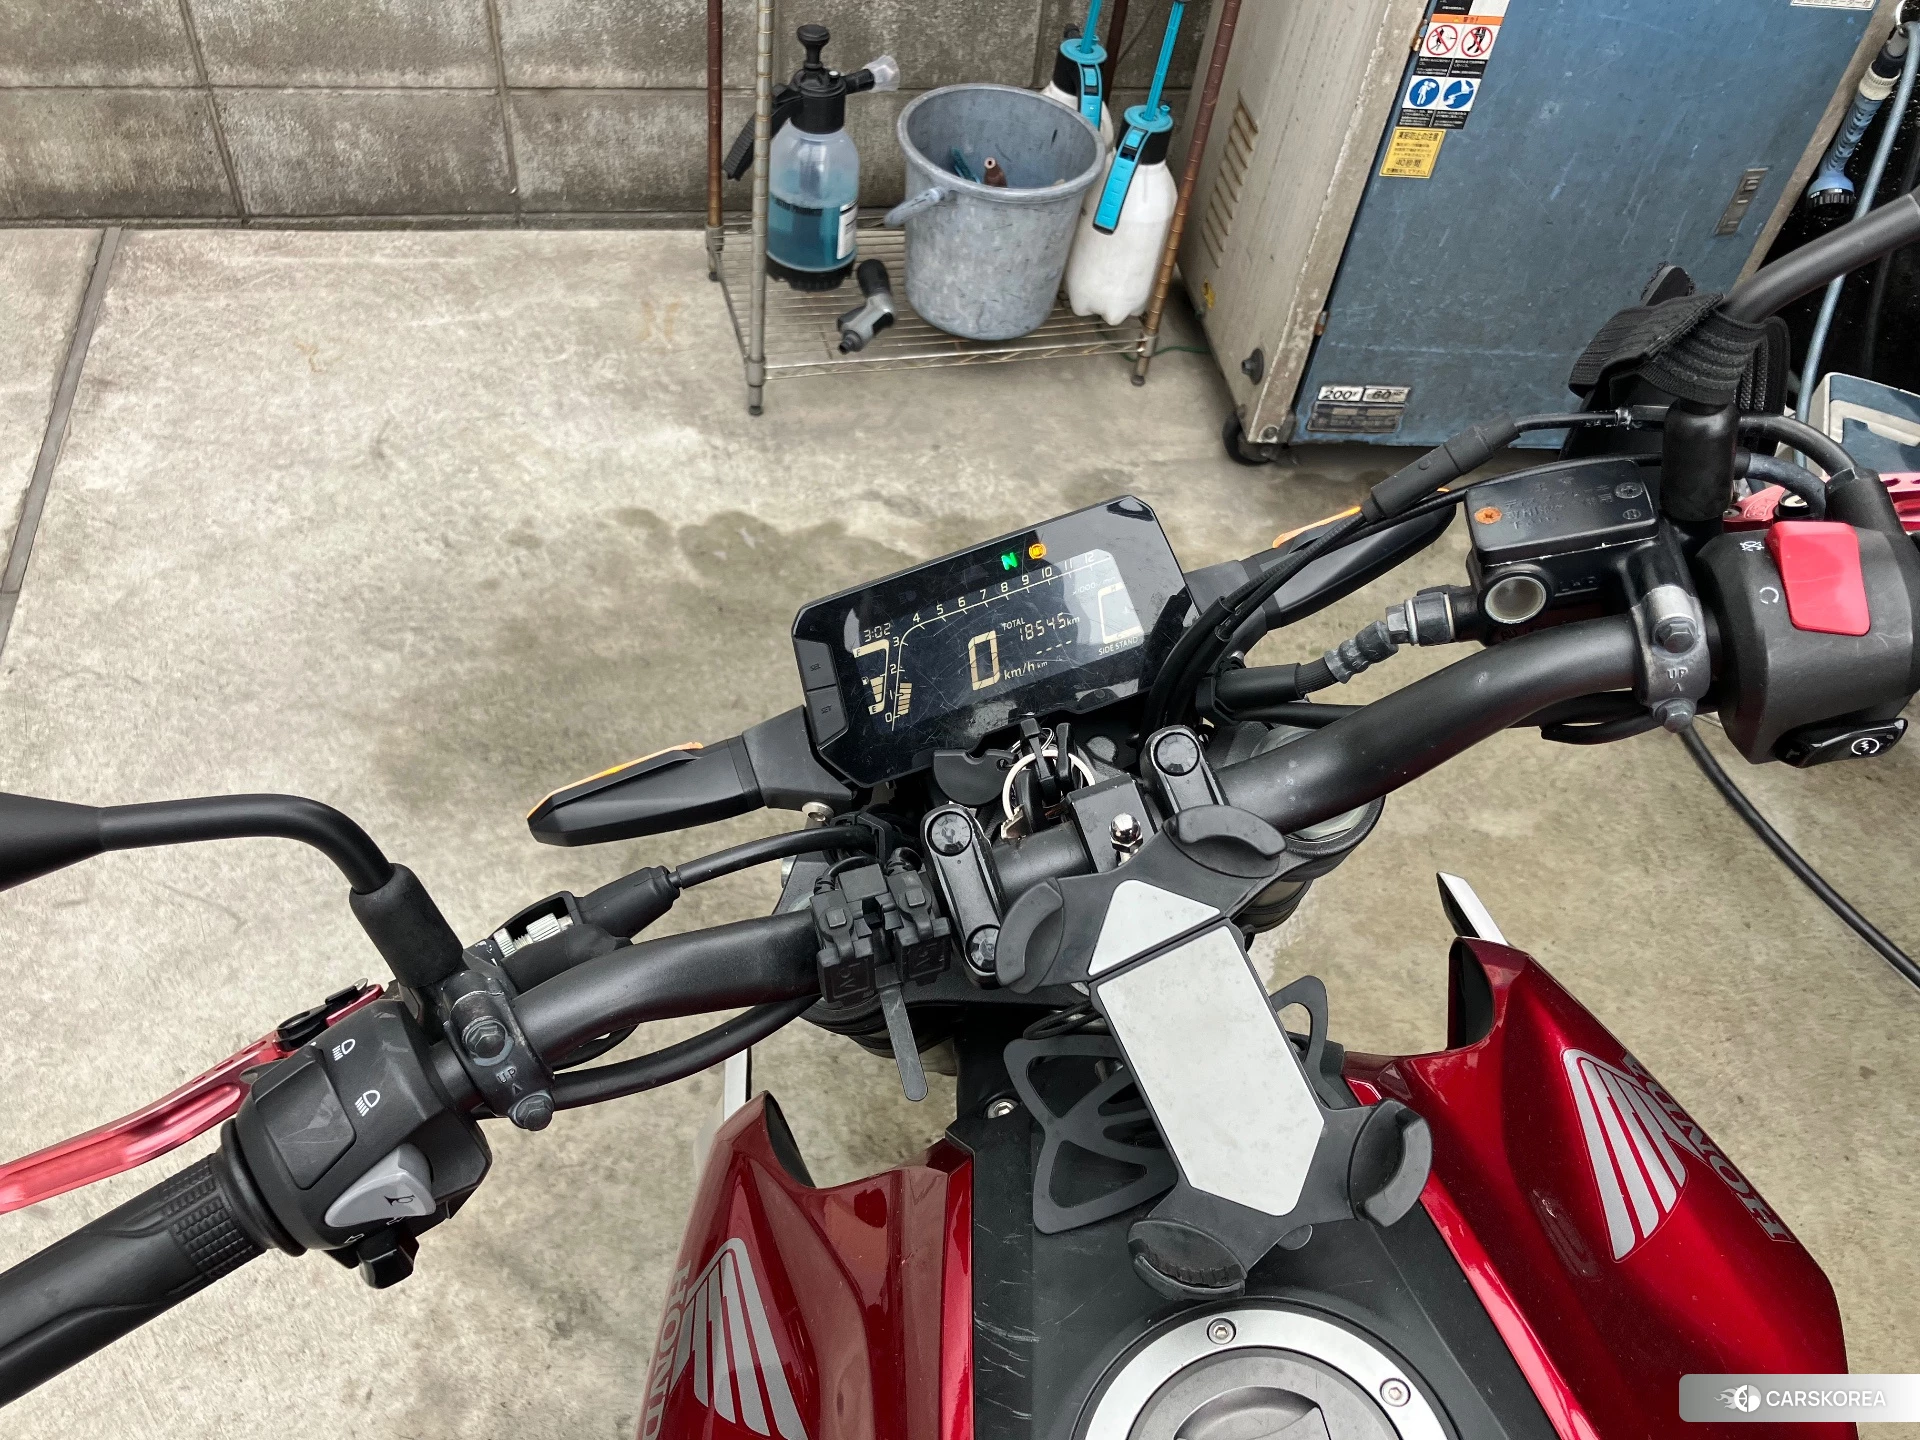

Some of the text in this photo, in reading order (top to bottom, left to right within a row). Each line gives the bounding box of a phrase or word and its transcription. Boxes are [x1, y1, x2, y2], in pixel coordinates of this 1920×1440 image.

[1000, 551, 1018, 571] N
[912, 552, 1095, 624] 4 5 6 7 8 9 10 11 12
[1001, 617, 1026, 631] TOTAL
[1066, 615, 1080, 626] km
[864, 622, 891, 643] 3:02
[892, 636, 900, 647] 3
[1098, 636, 1140, 656] SIDE STAND
[968, 630, 1035, 691] 0 km/h
[889, 663, 898, 675] 2
[1666, 666, 1689, 680] UP
[889, 689, 893, 700] 1
[884, 712, 892, 723] 0
[496, 1067, 518, 1085] UP
